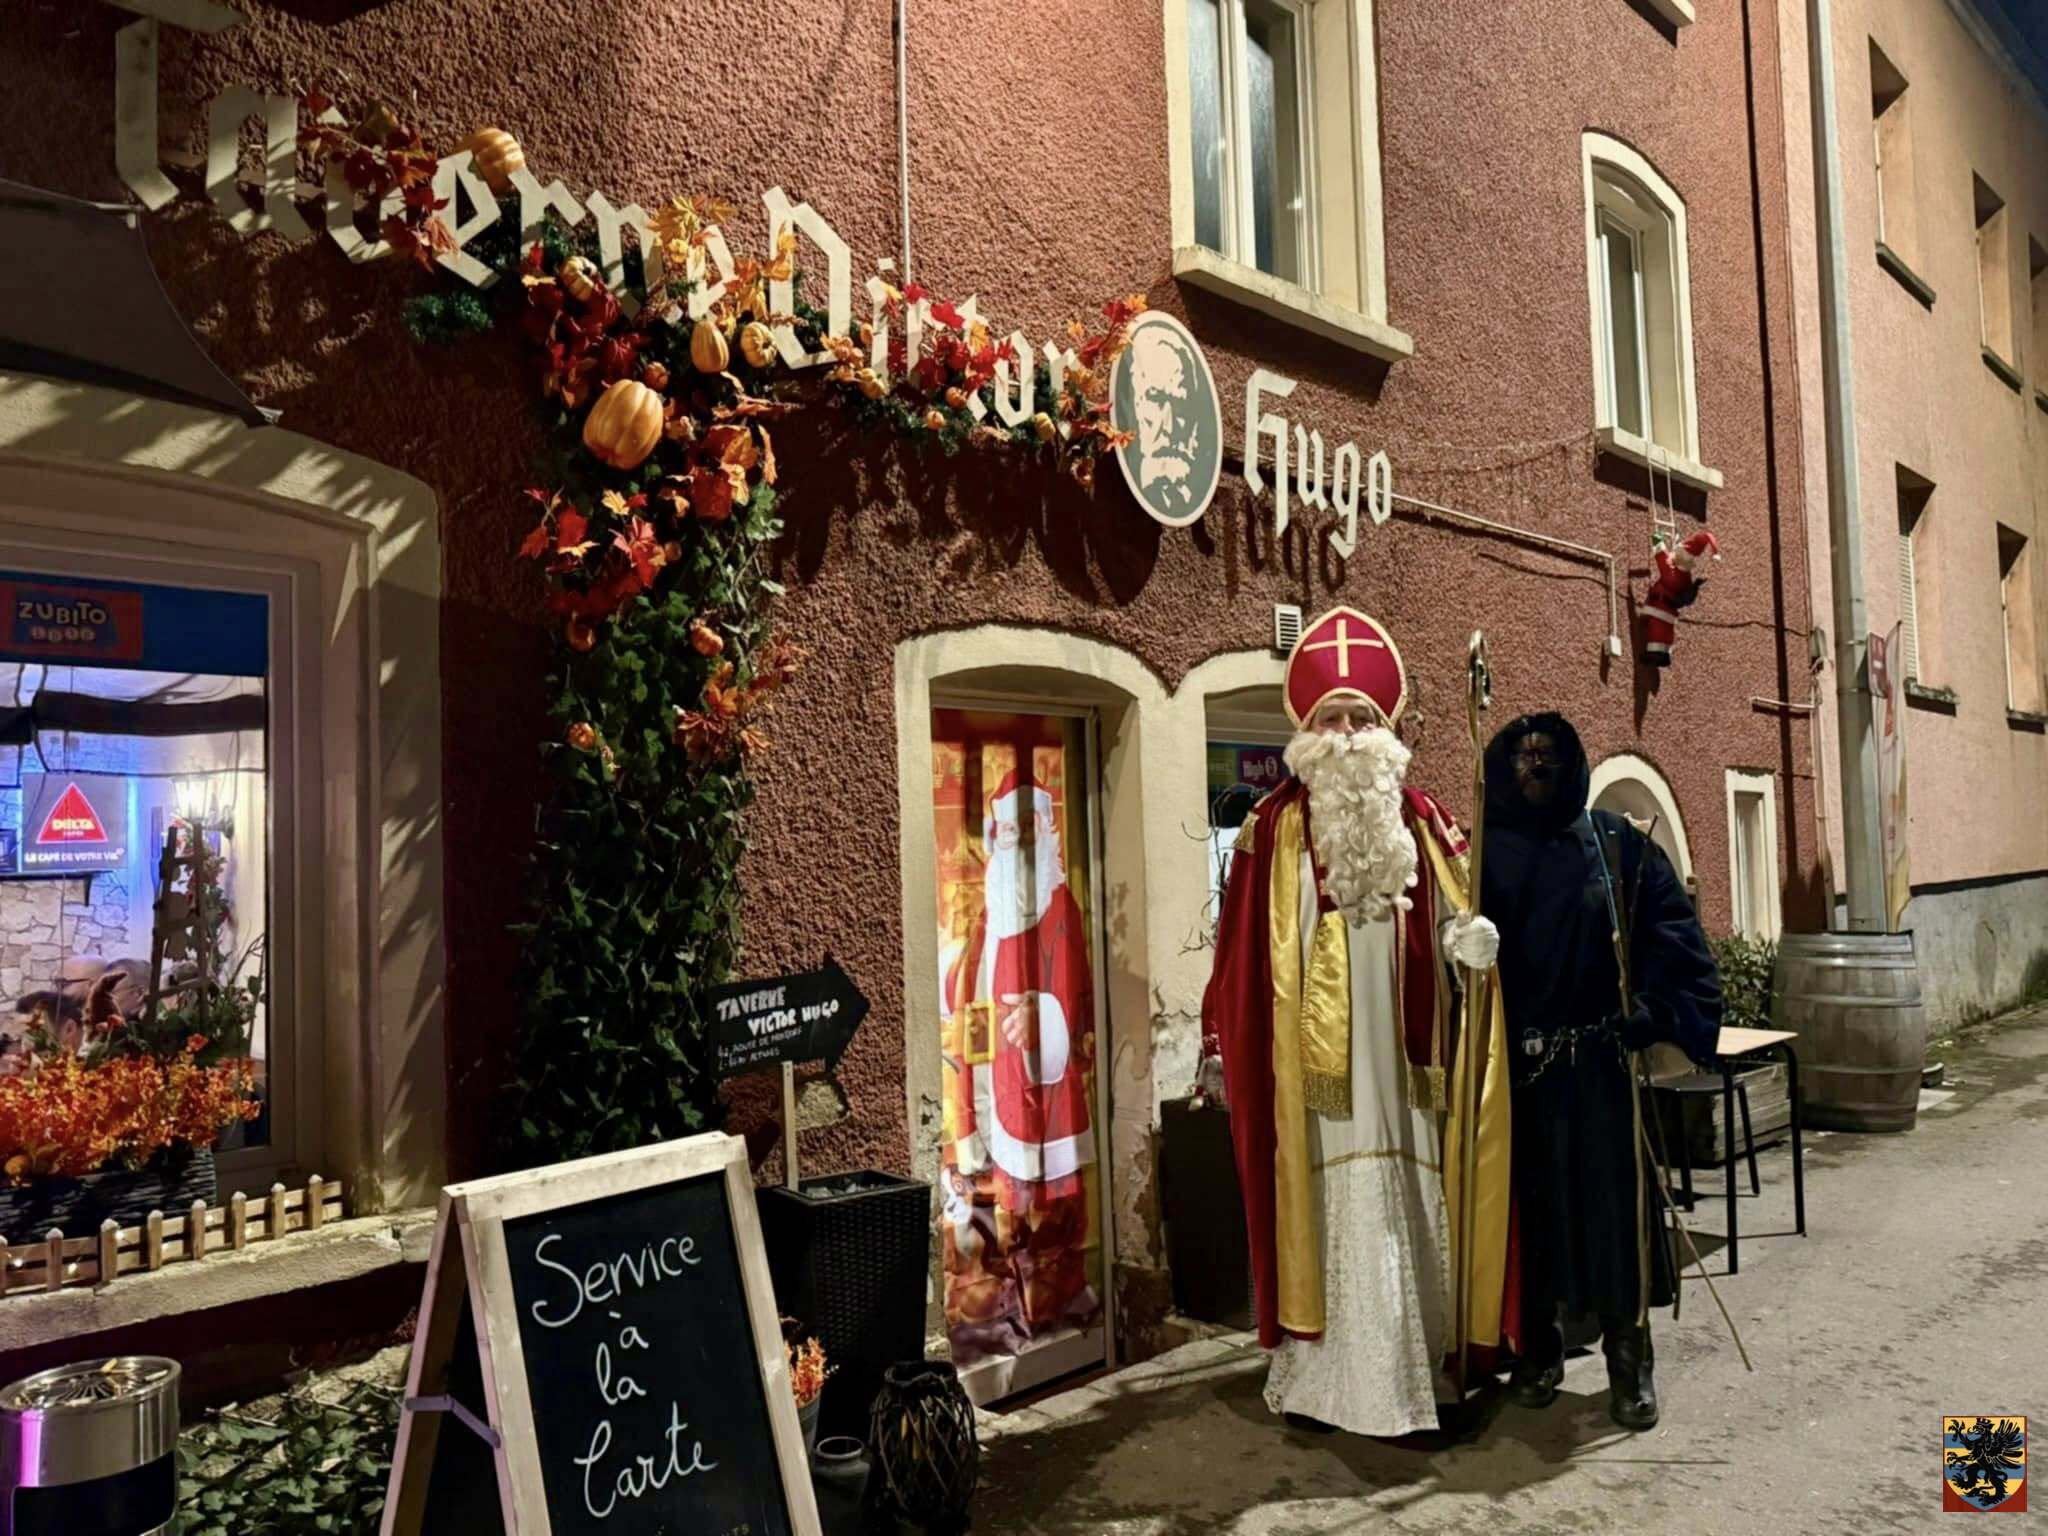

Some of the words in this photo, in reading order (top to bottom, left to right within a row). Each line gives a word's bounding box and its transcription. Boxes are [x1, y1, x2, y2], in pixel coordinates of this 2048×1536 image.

[1244, 368, 1393, 560] Hugo
[18, 601, 108, 625] ZUBITO
[716, 985, 787, 1022] TAVERNE
[747, 1008, 797, 1037] VICTOR
[801, 998, 840, 1022] HUGO
[531, 1234, 702, 1328] Service
[608, 1311, 650, 1350] à
[596, 1342, 647, 1405] la
[573, 1400, 719, 1518] Carte
